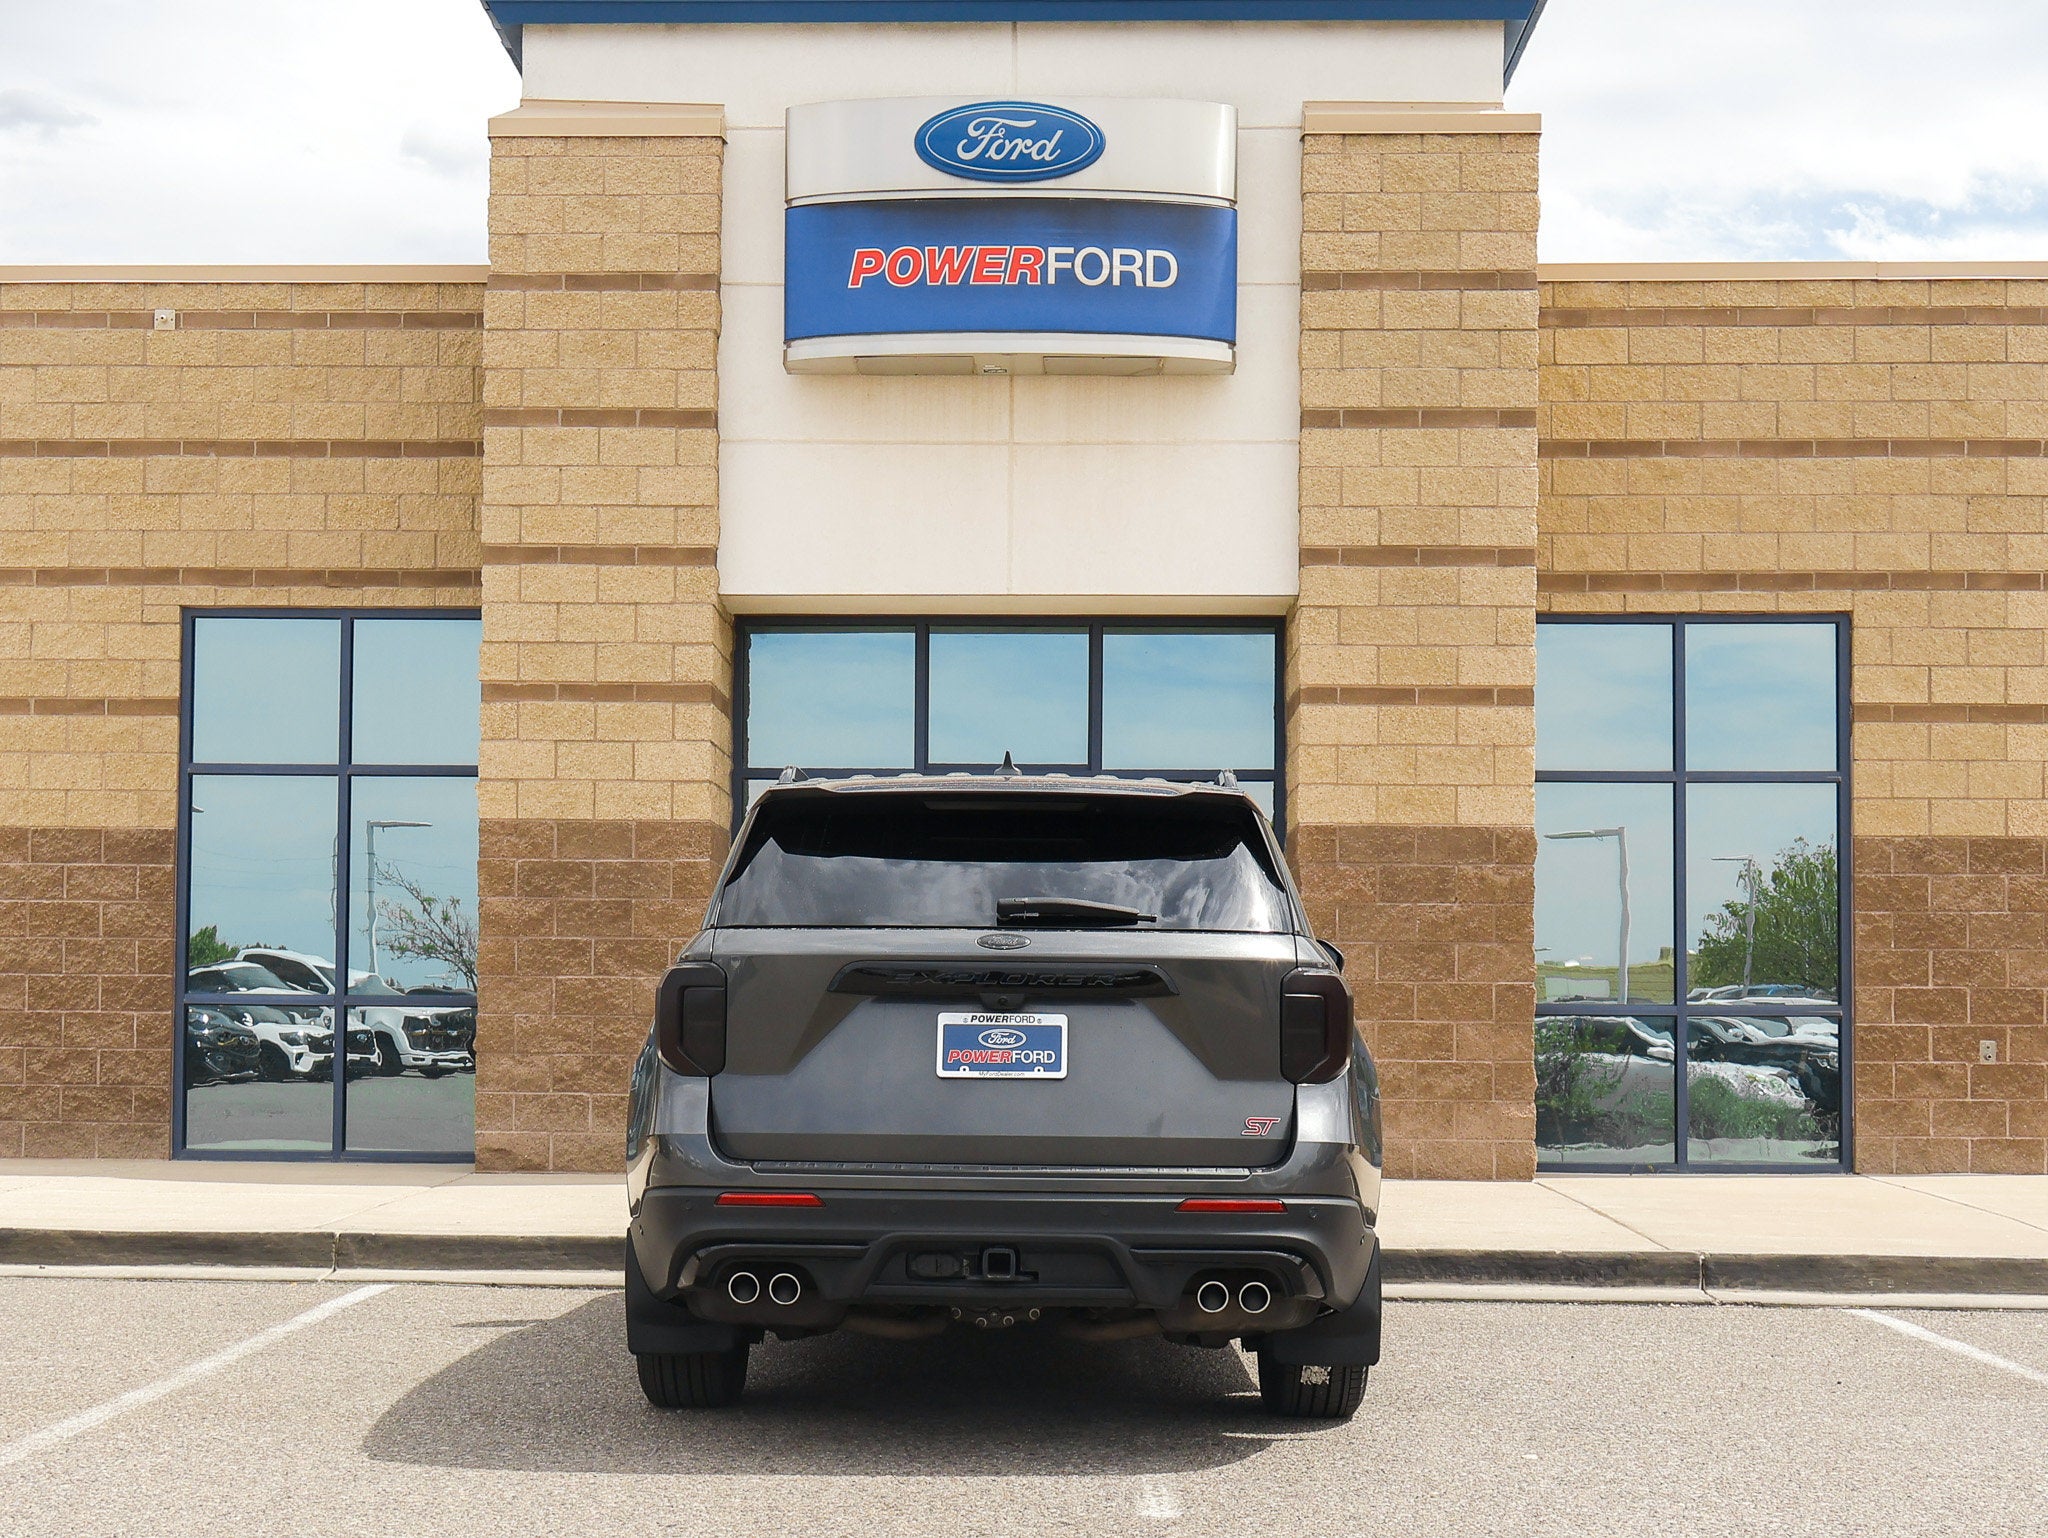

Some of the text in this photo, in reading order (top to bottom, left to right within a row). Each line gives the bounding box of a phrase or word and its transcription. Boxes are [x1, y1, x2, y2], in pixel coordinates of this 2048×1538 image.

[956, 117, 1062, 161] Ford
[847, 245, 1178, 289] POWERFORD
[886, 972, 1117, 986] EXPLORER
[970, 1015, 1036, 1024] POWERFORD
[987, 1032, 1017, 1044] Ford
[947, 1049, 1056, 1064] POWERFORD
[1241, 1116, 1281, 1136] ST
